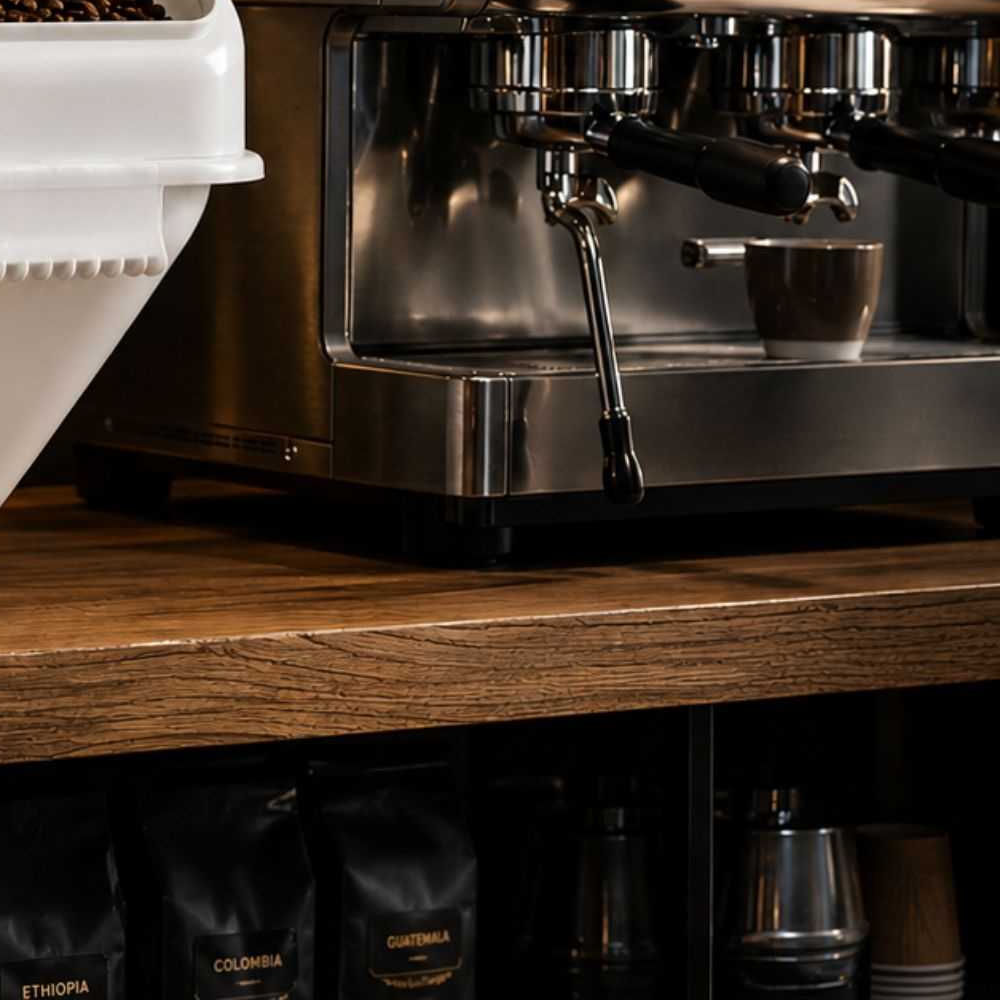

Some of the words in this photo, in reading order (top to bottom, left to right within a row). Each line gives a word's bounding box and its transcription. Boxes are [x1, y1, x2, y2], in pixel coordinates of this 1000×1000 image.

[386, 929, 452, 950] GUATEMALA
[213, 953, 284, 973] COLOMBIA
[22, 979, 90, 1000] ETHIOPIA
